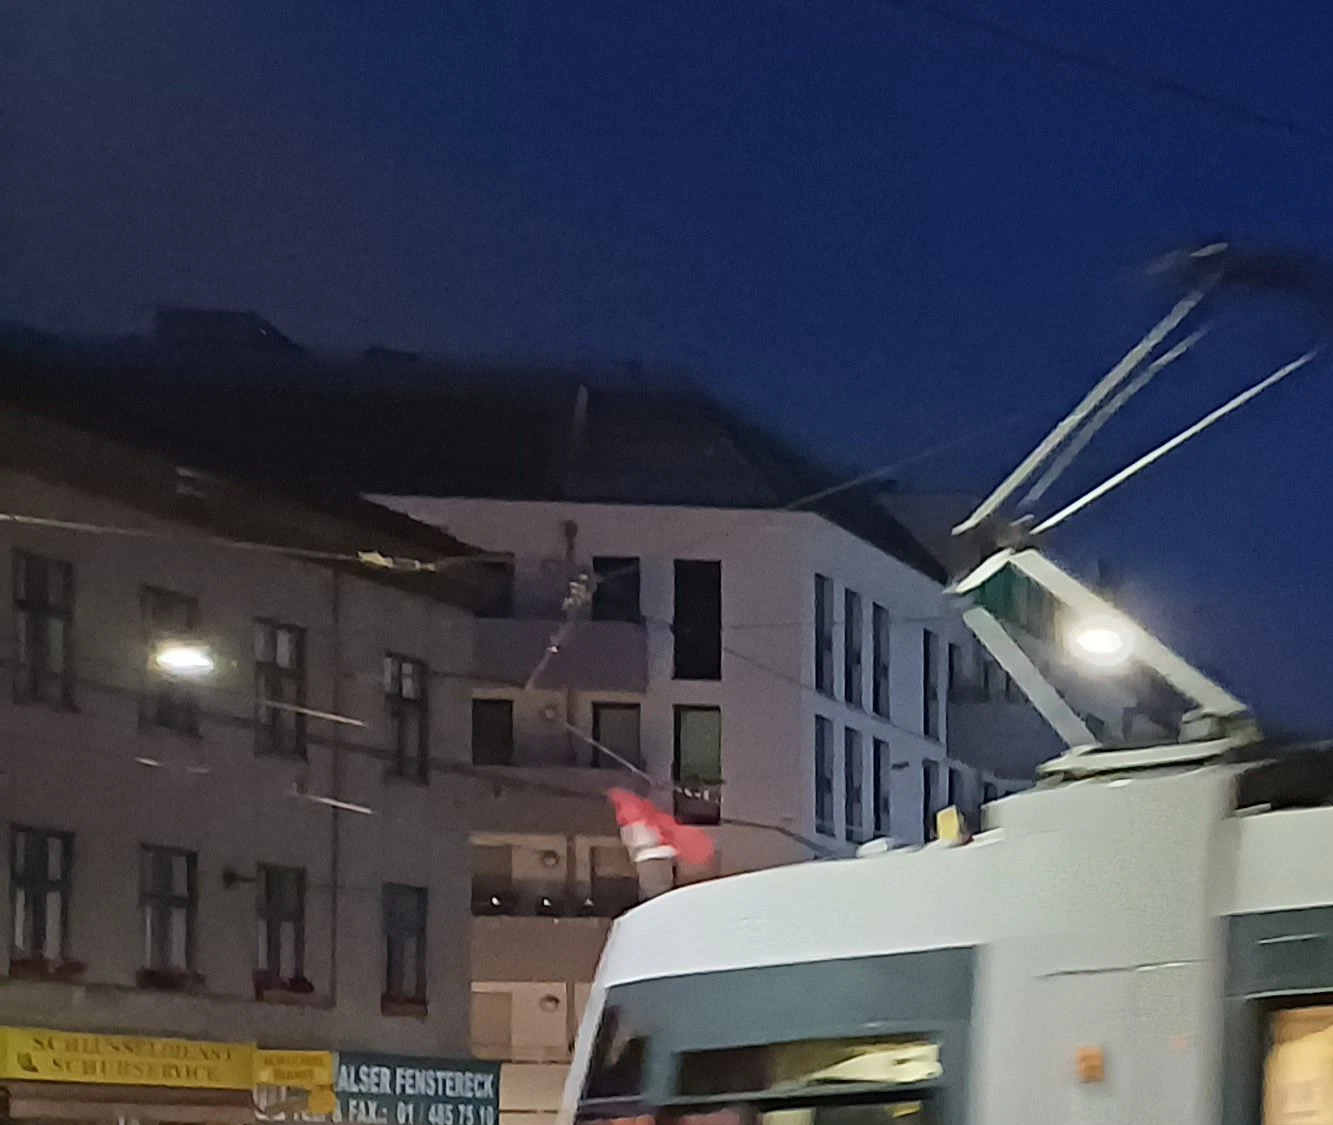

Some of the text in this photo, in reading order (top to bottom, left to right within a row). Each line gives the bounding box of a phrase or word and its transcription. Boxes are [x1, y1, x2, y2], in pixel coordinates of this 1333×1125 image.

[336, 1064, 495, 1098] ALSER FENSTERECK
[396, 1100, 414, 1125] 01
